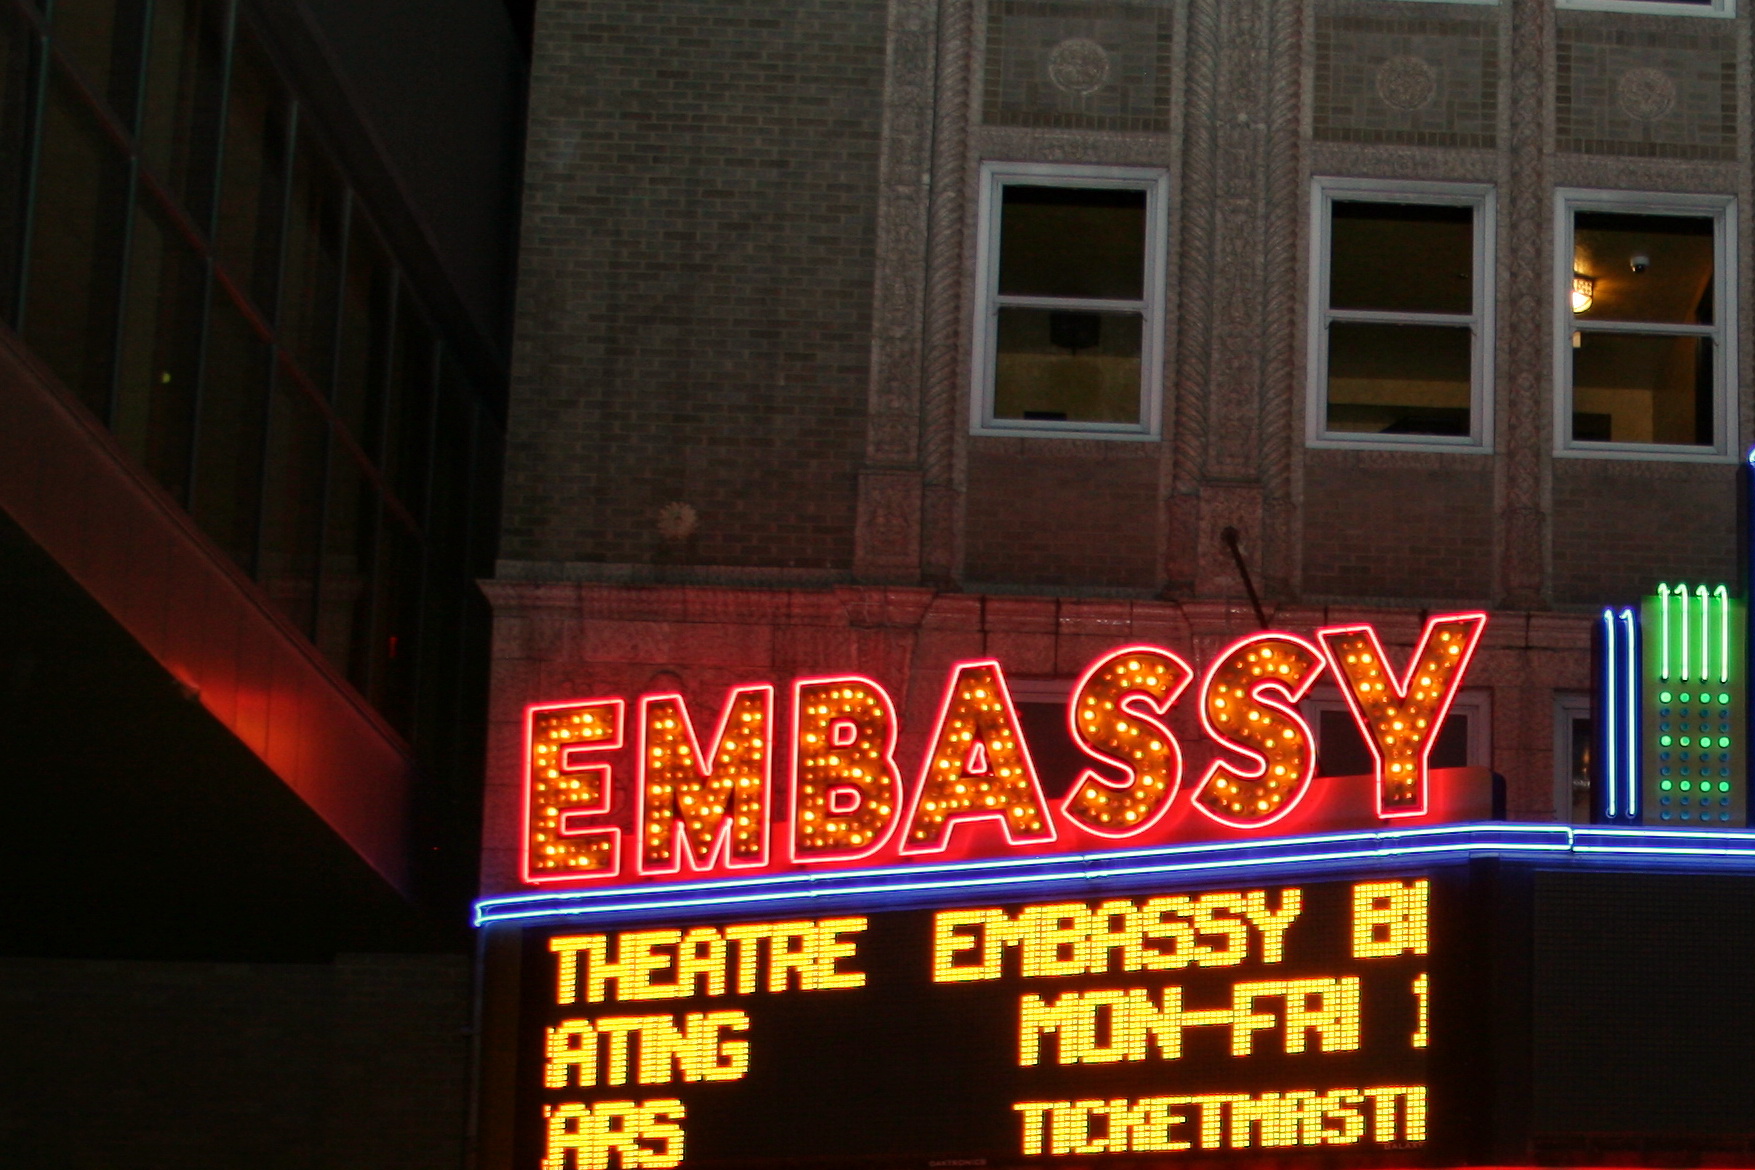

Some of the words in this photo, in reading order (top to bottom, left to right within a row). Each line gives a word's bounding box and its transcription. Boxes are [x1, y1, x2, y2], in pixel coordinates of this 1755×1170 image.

[521, 611, 1487, 884] EMBASSY
[548, 916, 868, 1005] THEATRE
[932, 888, 1302, 985] EMBASSY
[544, 1011, 750, 1088] ATING
[1018, 977, 1361, 1067] MON-FRI
